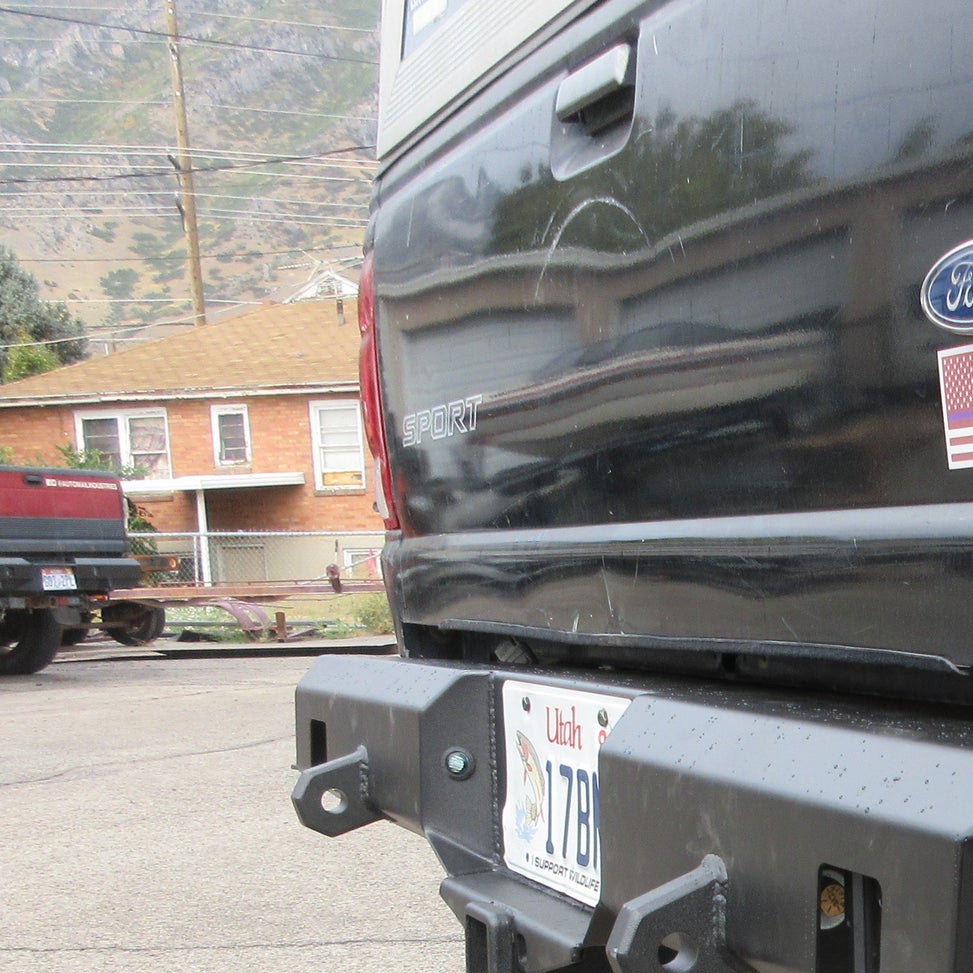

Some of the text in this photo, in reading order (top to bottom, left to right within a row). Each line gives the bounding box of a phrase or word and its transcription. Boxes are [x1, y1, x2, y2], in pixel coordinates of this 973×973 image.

[402, 393, 483, 448] SPORT
[545, 705, 582, 750] Utah
[534, 856, 569, 879] SUPPORT
[569, 869, 600, 892] WILDLIFE
